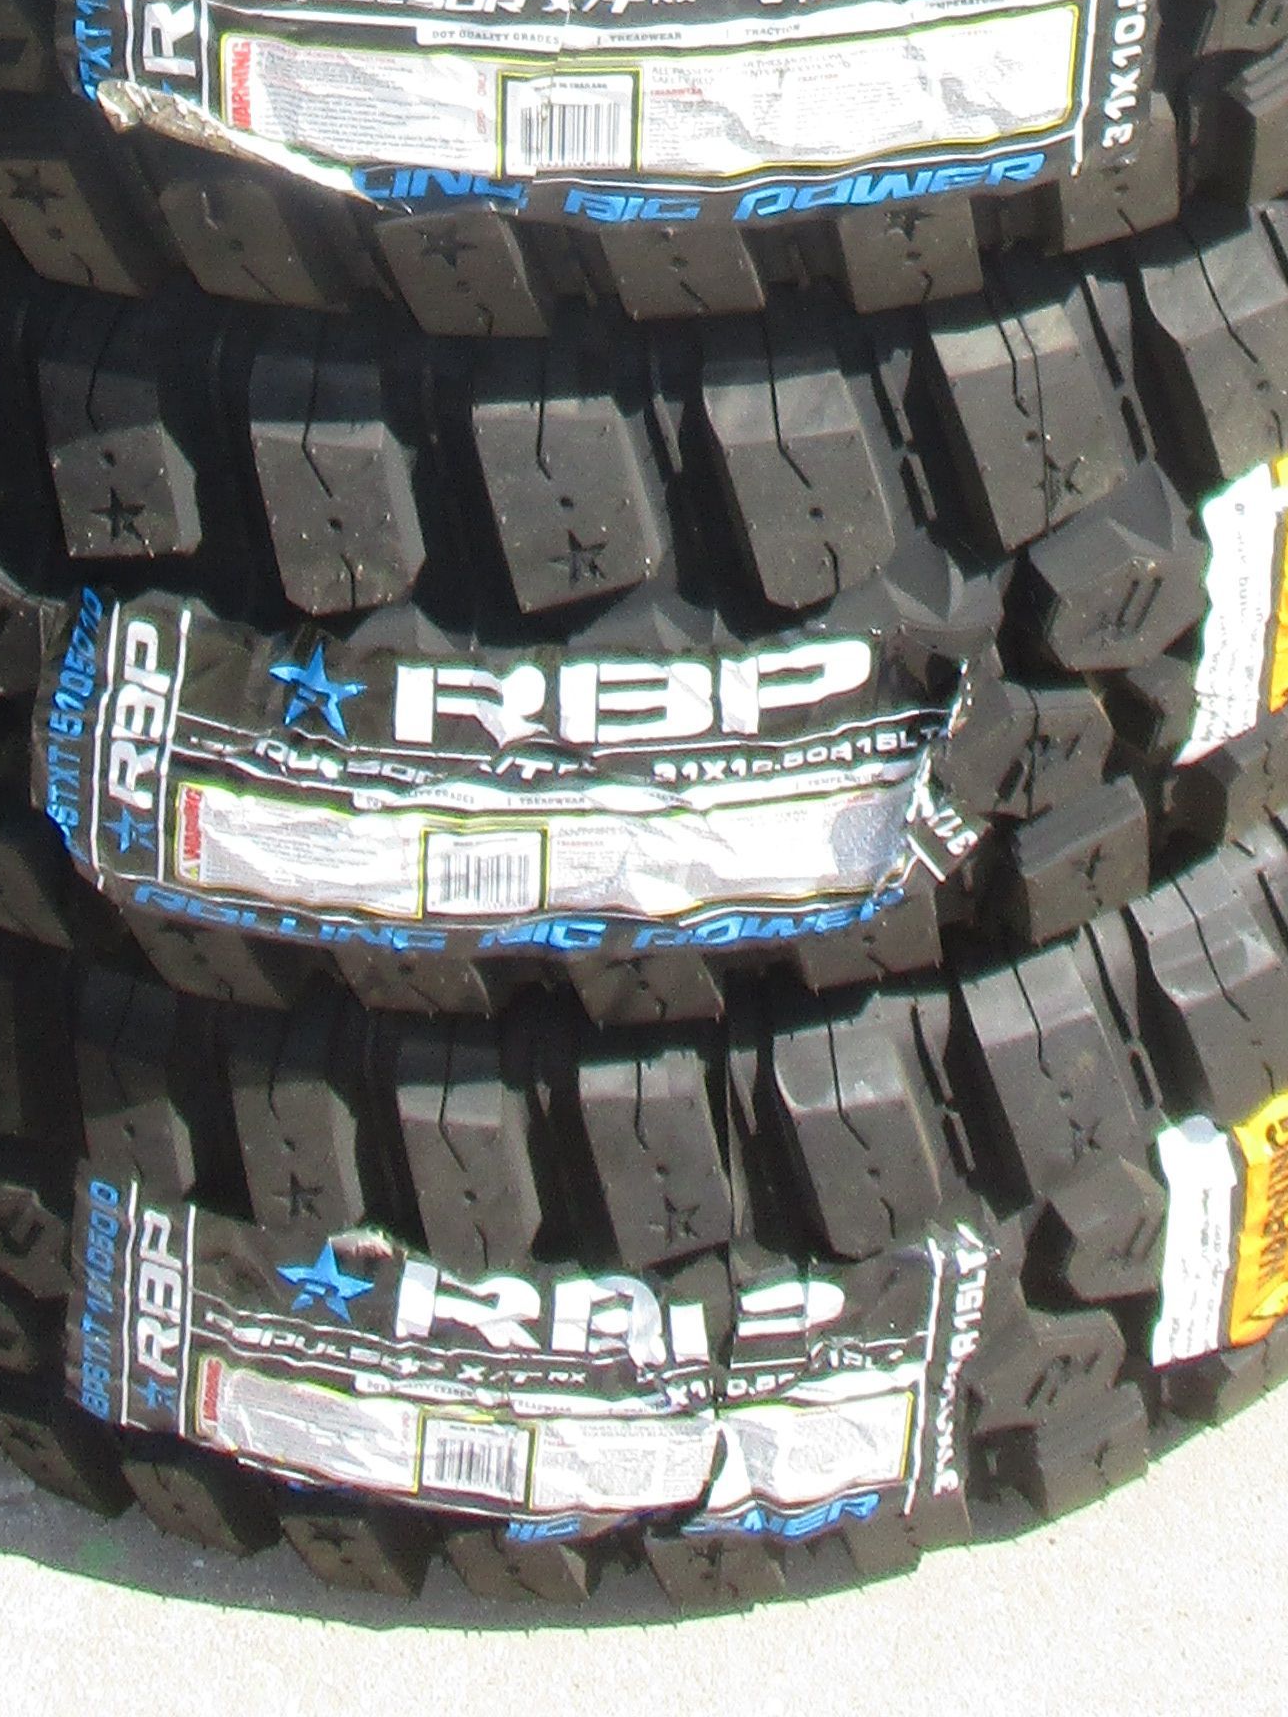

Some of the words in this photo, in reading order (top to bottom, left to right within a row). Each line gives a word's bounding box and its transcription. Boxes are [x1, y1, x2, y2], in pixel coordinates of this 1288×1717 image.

[432, 29, 455, 40] DOT
[459, 29, 510, 42] QUALITY
[512, 32, 561, 45] GRADES
[609, 30, 683, 43] TREADWEAR
[732, 151, 1047, 222] POWER
[108, 620, 171, 811] RBP
[395, 639, 872, 748] RBP
[136, 1208, 183, 1379] RBP
